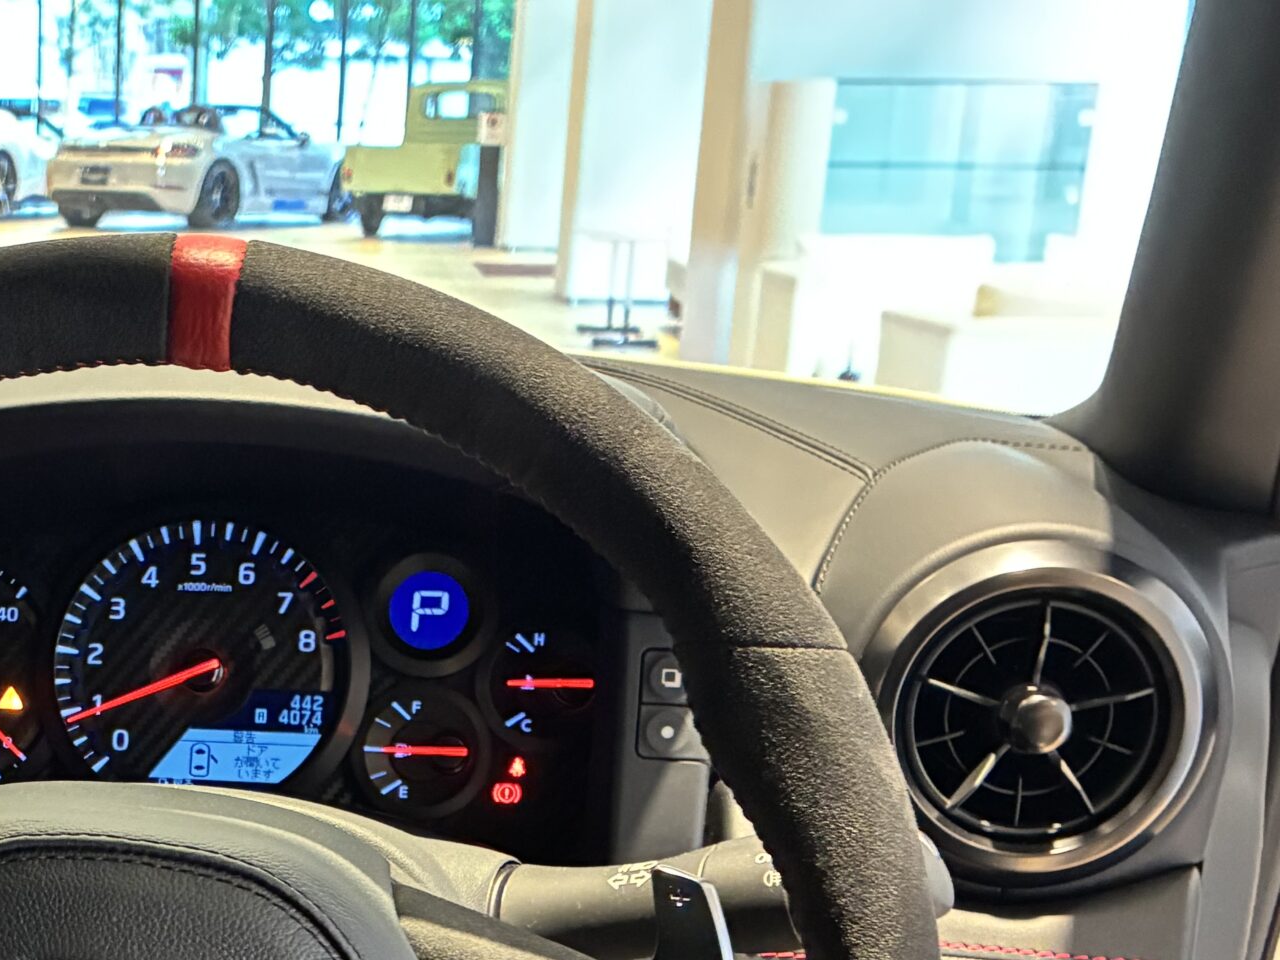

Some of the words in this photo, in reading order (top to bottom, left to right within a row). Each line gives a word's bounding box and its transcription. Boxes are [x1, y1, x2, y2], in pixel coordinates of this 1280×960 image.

[190, 553, 207, 575] 5
[238, 562, 255, 585] 6
[141, 566, 159, 588] 4
[109, 597, 126, 620] 3
[277, 592, 294, 614] 7
[410, 590, 450, 632] P
[298, 629, 316, 653] 8
[534, 633, 546, 646] H
[86, 642, 104, 665] 2
[92, 694, 103, 716] 1
[290, 695, 324, 710] 442
[412, 701, 422, 713] F
[278, 709, 322, 725] 4074
[521, 719, 532, 732] C
[112, 728, 130, 751] 0
[399, 786, 408, 798] E
